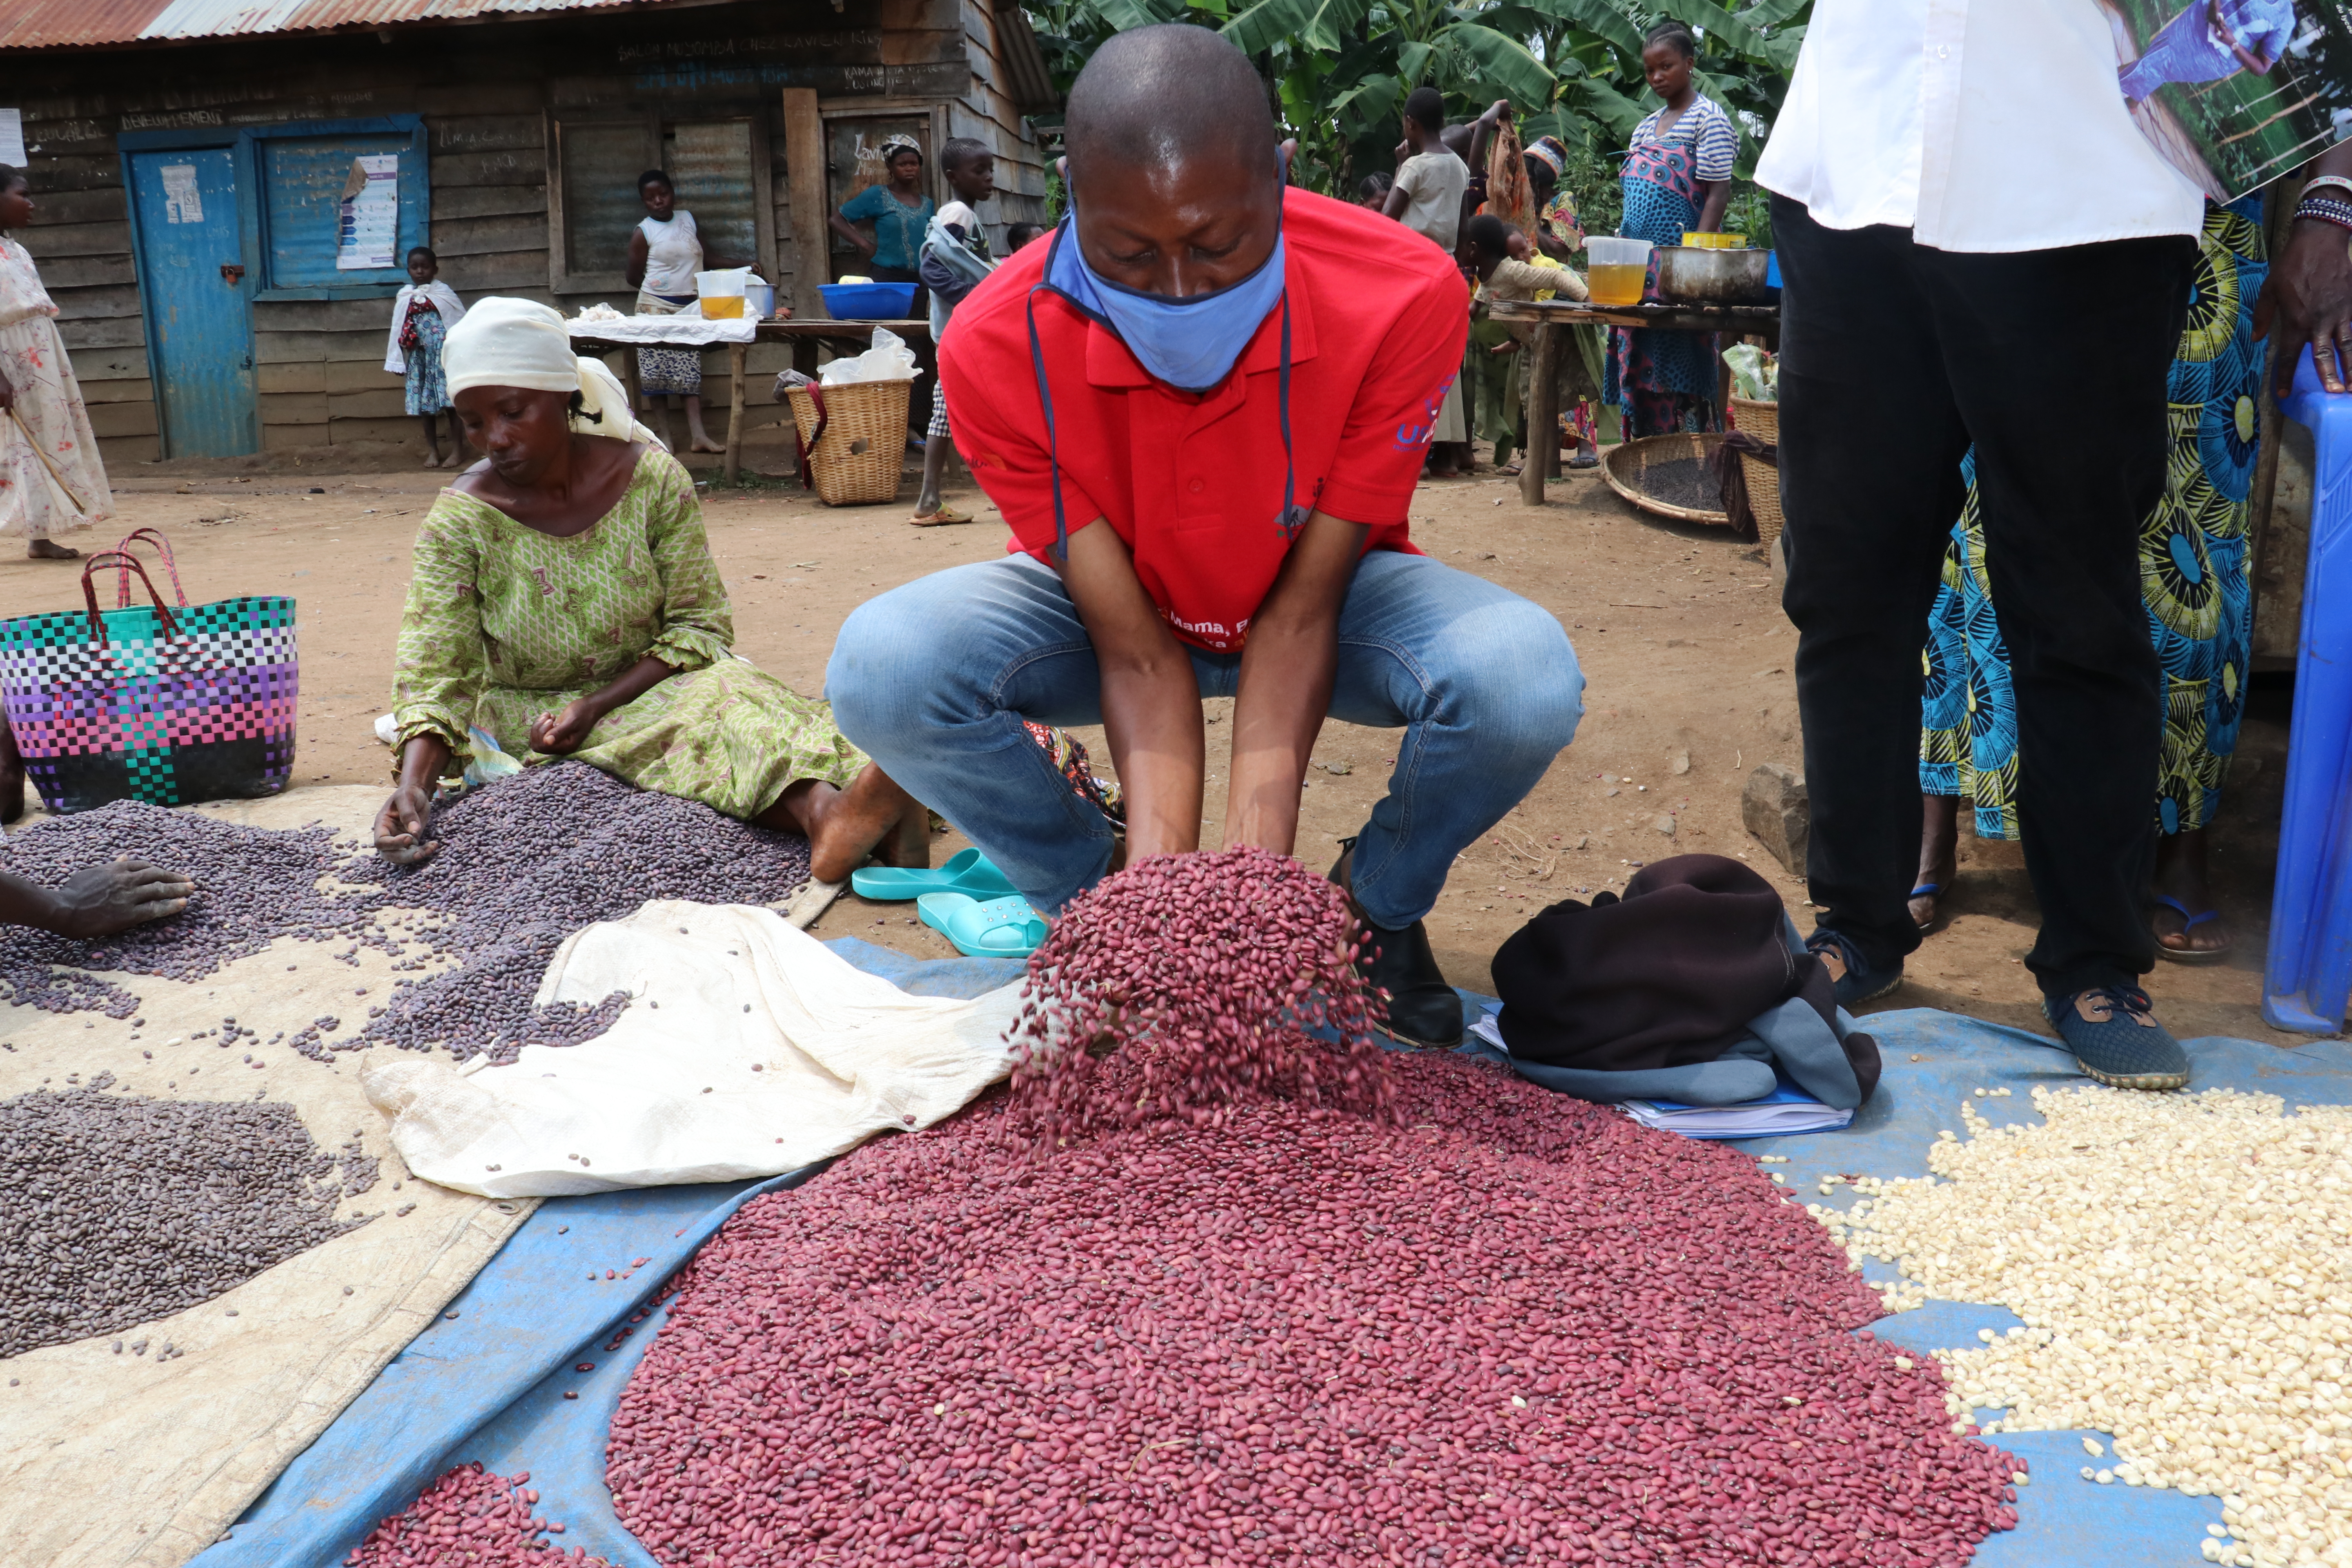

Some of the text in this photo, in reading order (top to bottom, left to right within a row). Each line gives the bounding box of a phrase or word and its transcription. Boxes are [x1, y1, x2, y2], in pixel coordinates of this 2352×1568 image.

[2336, 4, 2344, 14] du
[618, 43, 660, 62] SALON
[844, 66, 873, 80] KAMA
[1170, 610, 1231, 637] Mama,
[1236, 618, 1250, 634] B
